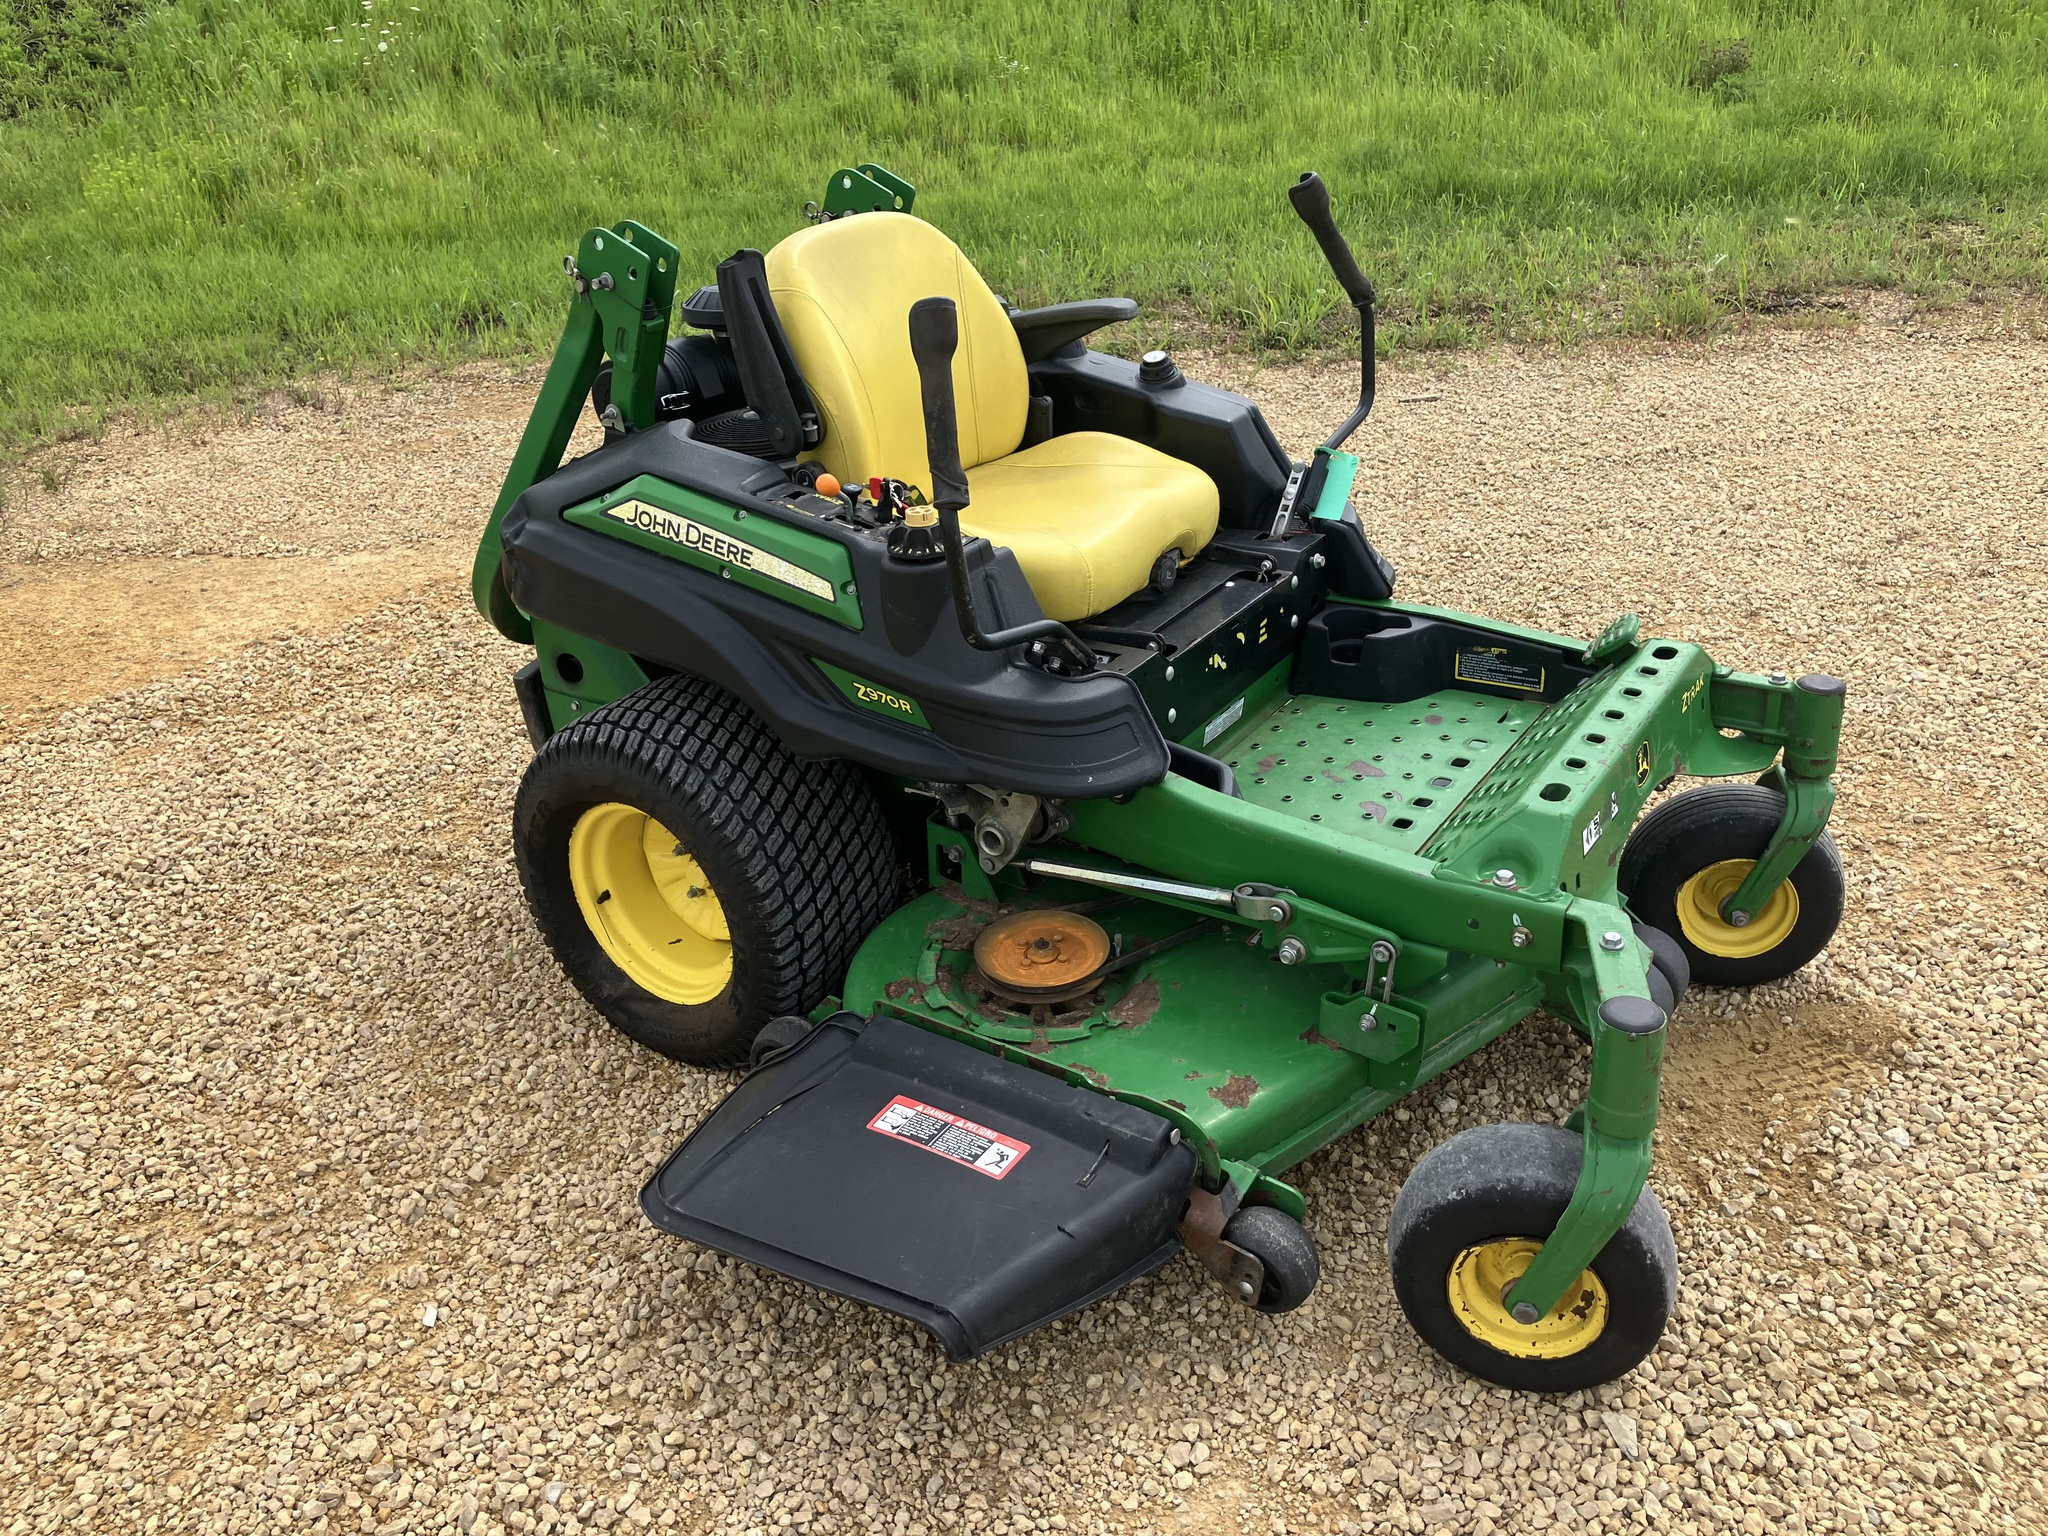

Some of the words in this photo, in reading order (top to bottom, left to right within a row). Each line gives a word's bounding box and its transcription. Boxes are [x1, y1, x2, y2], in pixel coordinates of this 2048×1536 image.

[626, 504, 681, 540] JOHN
[685, 524, 754, 567] DEERE
[852, 681, 913, 715] Z970R
[1681, 673, 1705, 714] ZTRAK
[923, 1106, 955, 1122] DANGER
[962, 1121, 998, 1139] PELIGRO
